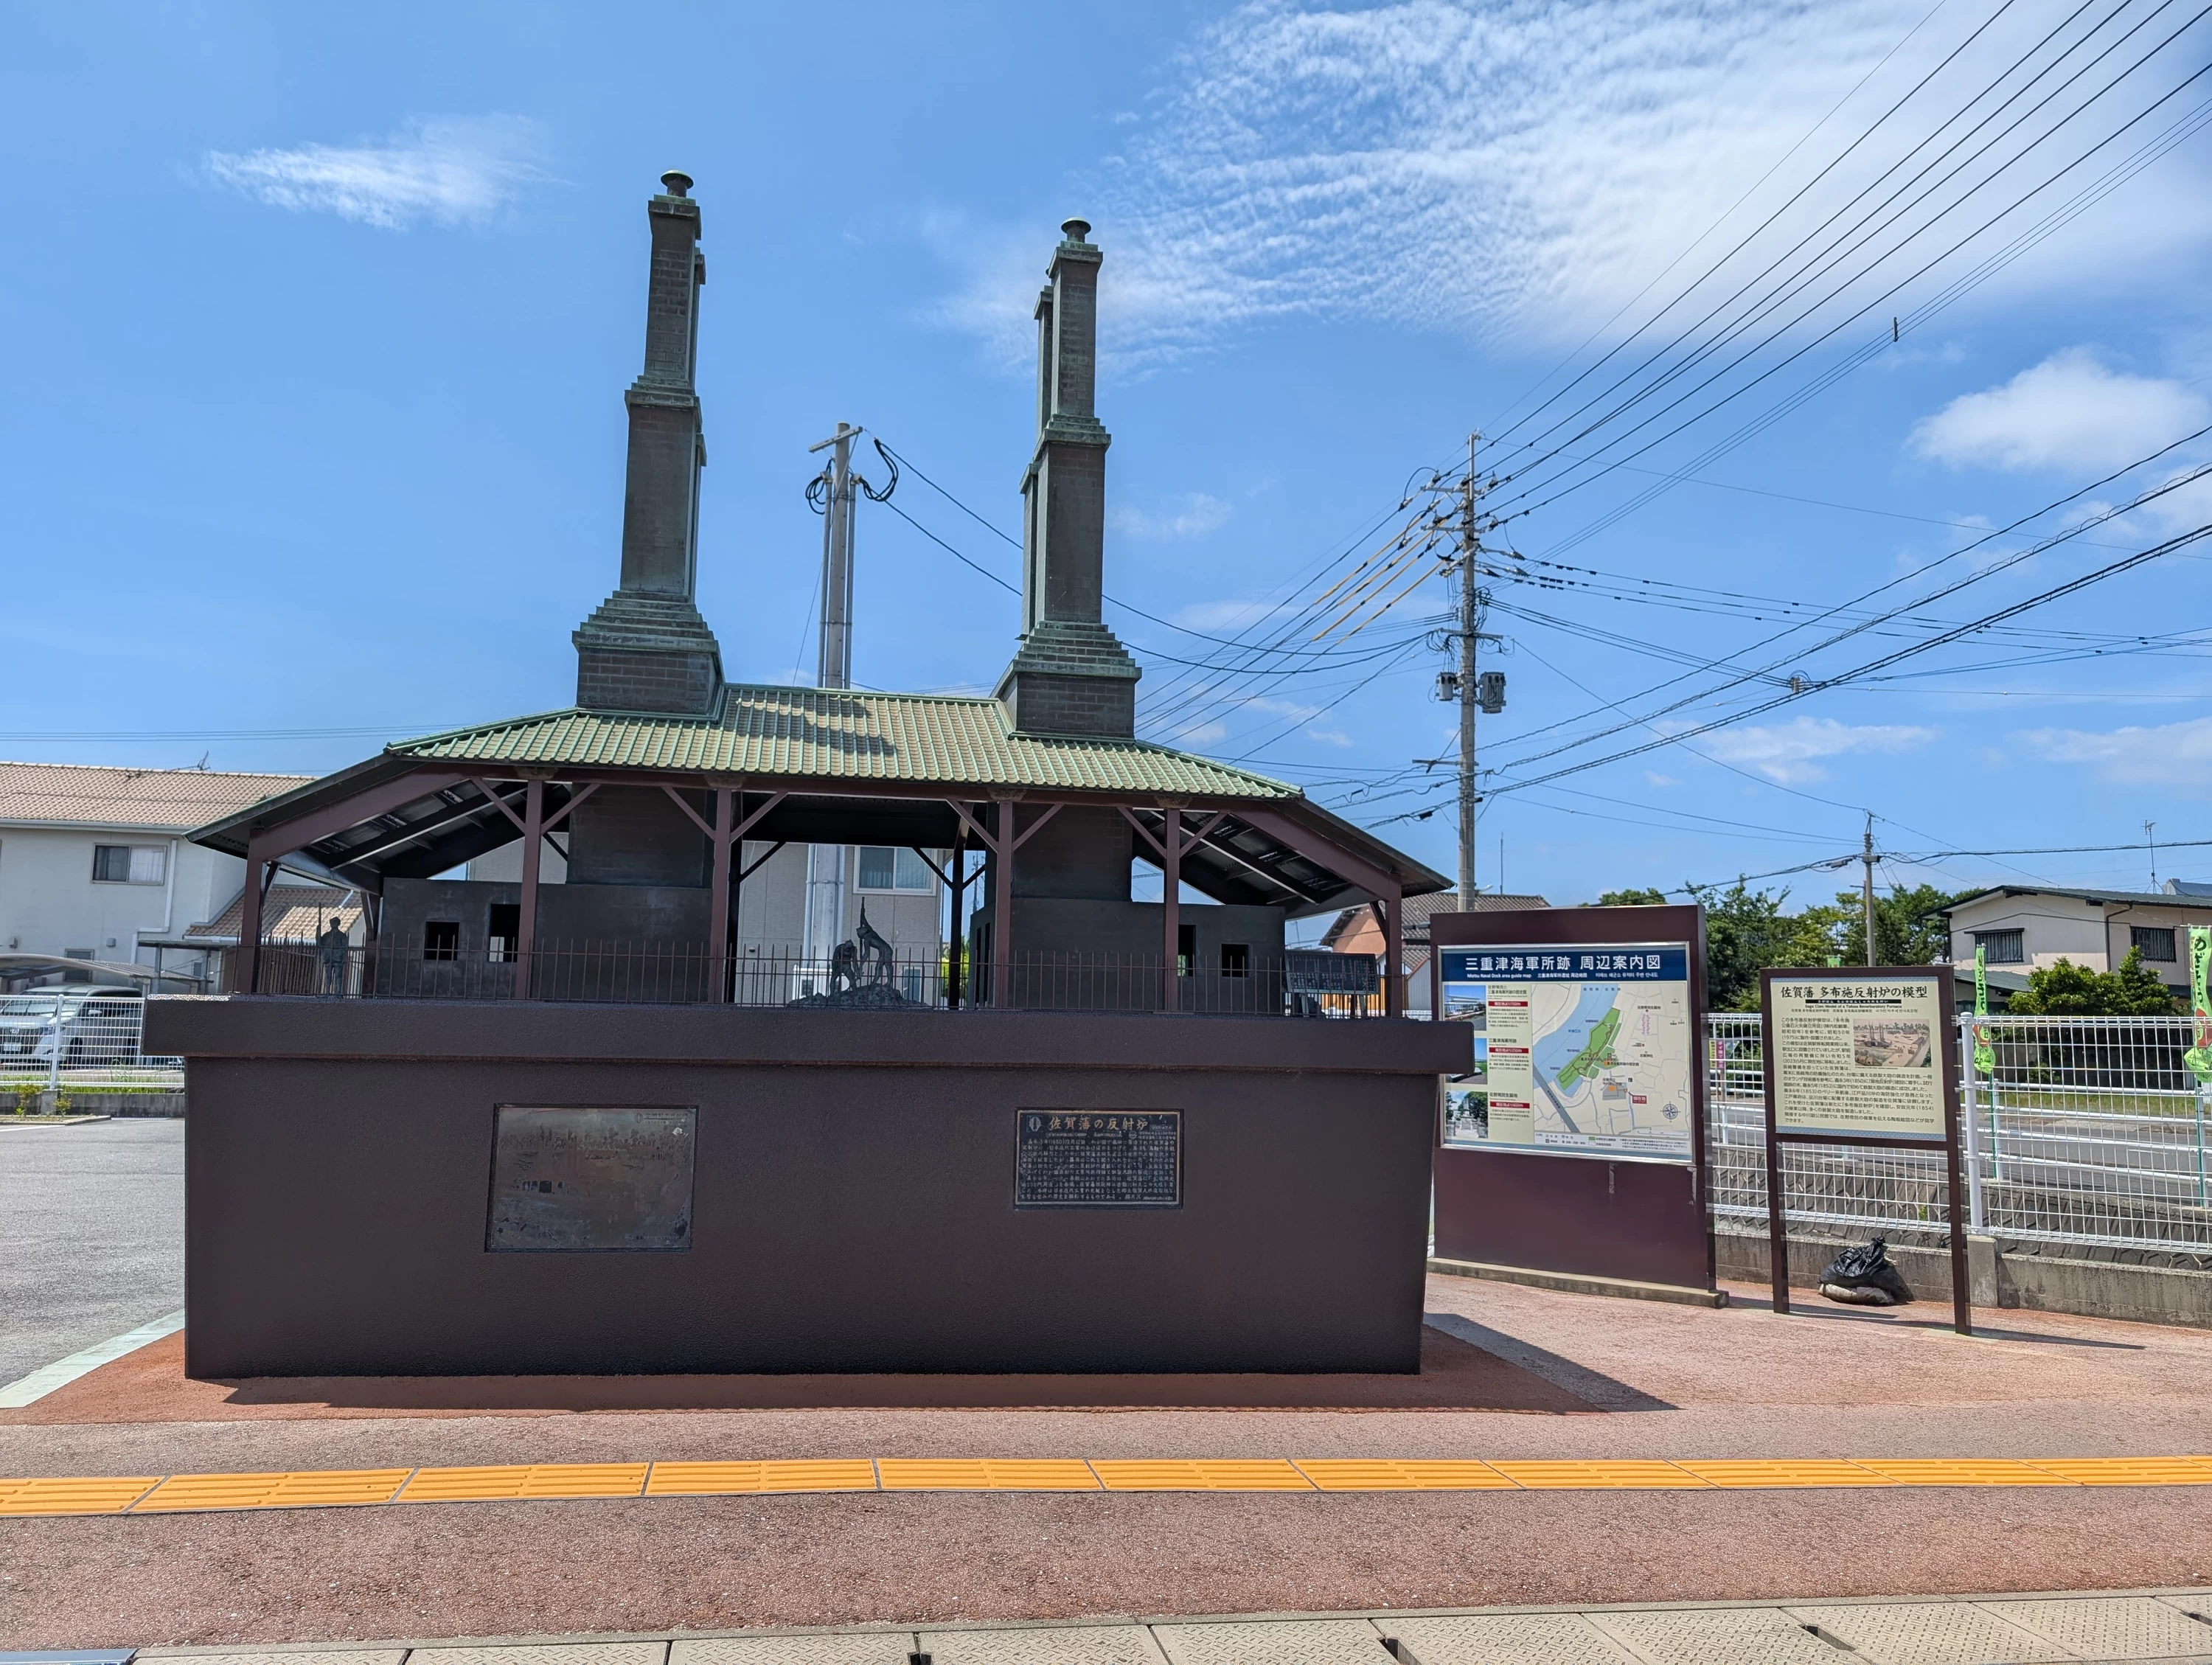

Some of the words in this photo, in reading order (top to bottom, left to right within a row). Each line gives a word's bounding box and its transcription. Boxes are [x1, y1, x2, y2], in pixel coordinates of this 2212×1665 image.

[1465, 956, 1571, 971] 三重津海軍所跡
[1580, 955, 1660, 970] 周辺案内図
[1781, 986, 1815, 998] 佐賀藩
[1820, 986, 1927, 998] 多布施反射炉の模型
[1048, 1116, 1148, 1130] 佐賀藩の反射炉
